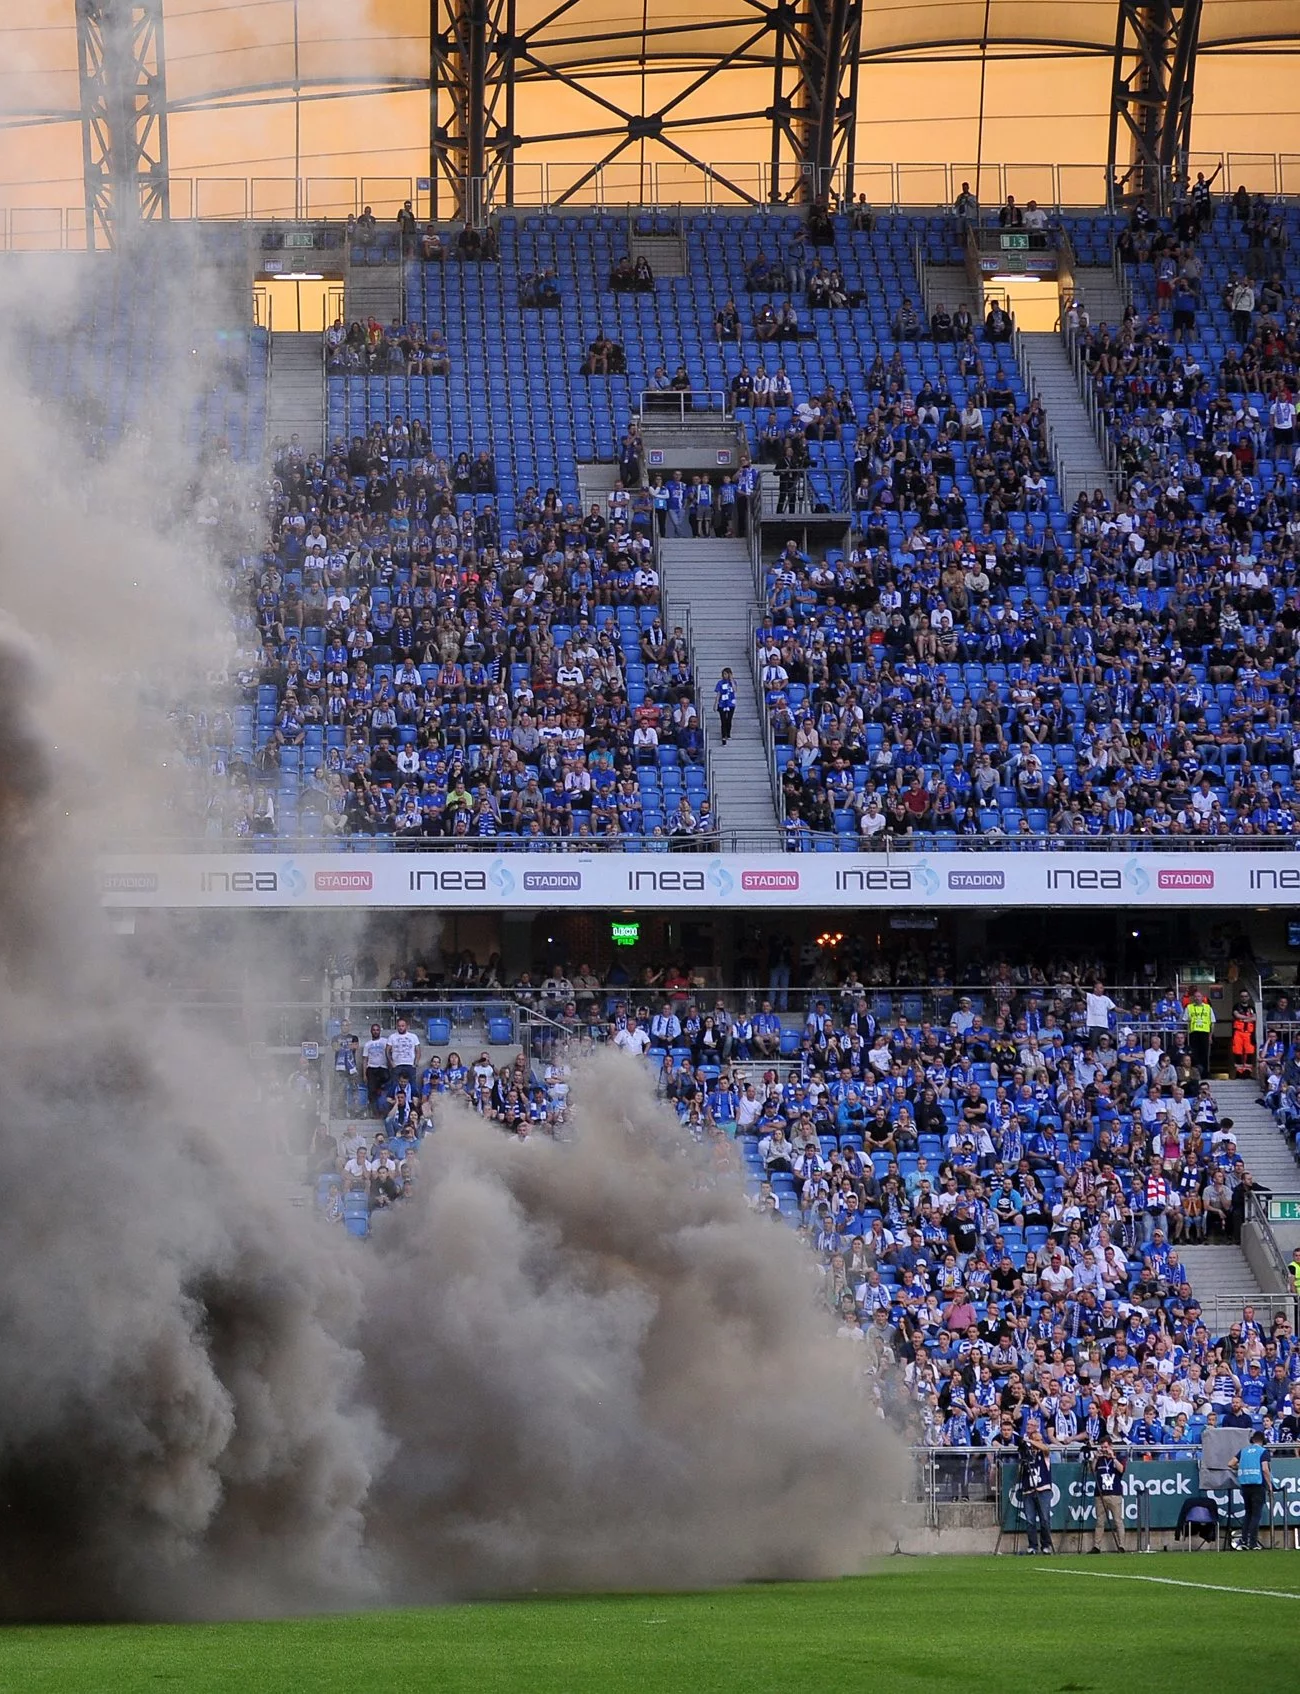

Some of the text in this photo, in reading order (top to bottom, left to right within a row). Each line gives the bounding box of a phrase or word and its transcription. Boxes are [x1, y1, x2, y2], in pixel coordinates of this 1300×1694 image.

[103, 877, 156, 888] STADION
[316, 875, 370, 887] STADION
[526, 875, 579, 887] STADION
[743, 875, 797, 887] STADION
[949, 875, 1003, 887] STADION
[1160, 874, 1212, 885] STADION
[1068, 1474, 1193, 1497] caback
[1068, 1498, 1139, 1520] wld
